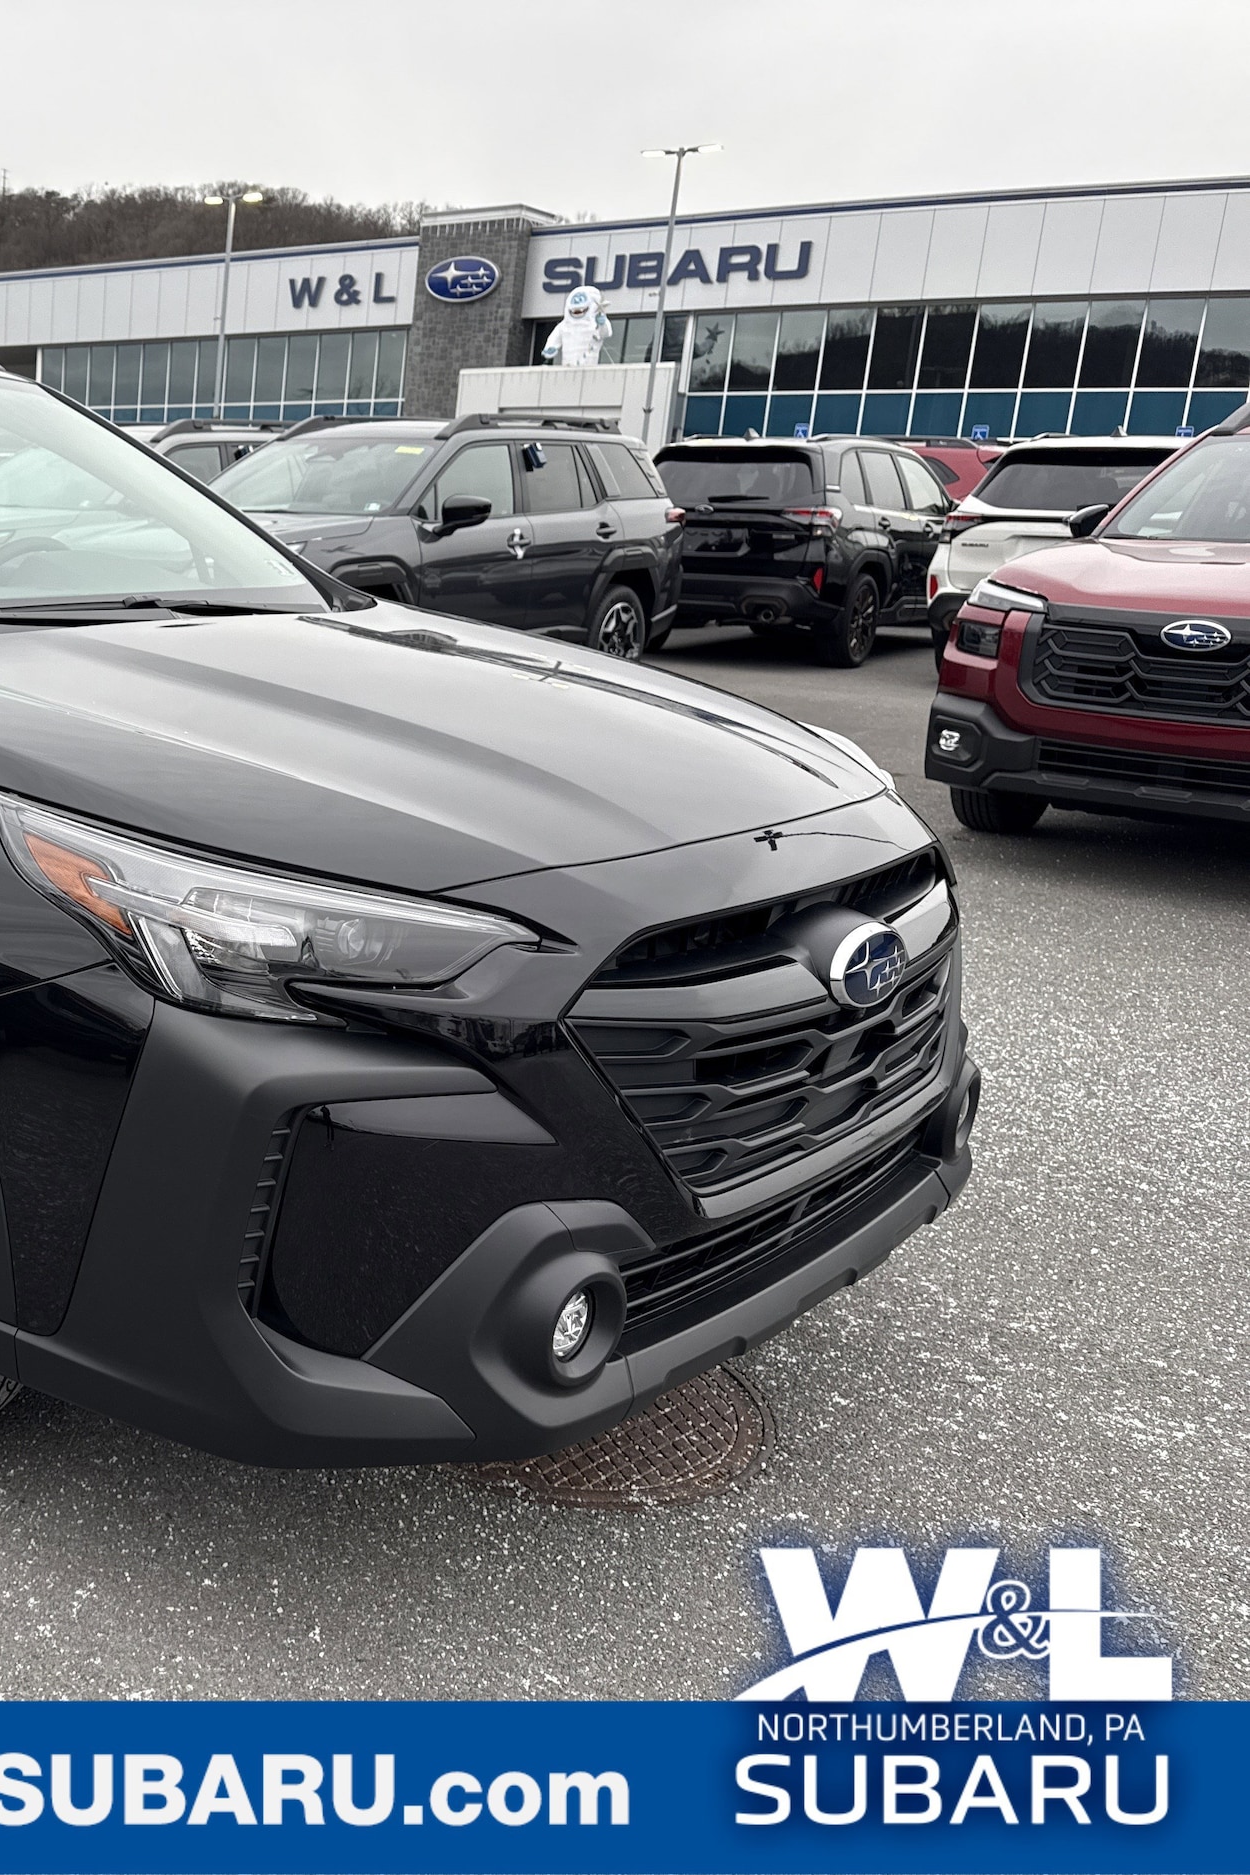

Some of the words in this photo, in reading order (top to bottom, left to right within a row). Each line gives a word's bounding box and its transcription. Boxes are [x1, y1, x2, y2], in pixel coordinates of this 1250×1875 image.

[288, 275, 327, 309] W
[334, 273, 362, 306] &
[372, 271, 396, 304] L
[542, 240, 814, 294] SUBARU
